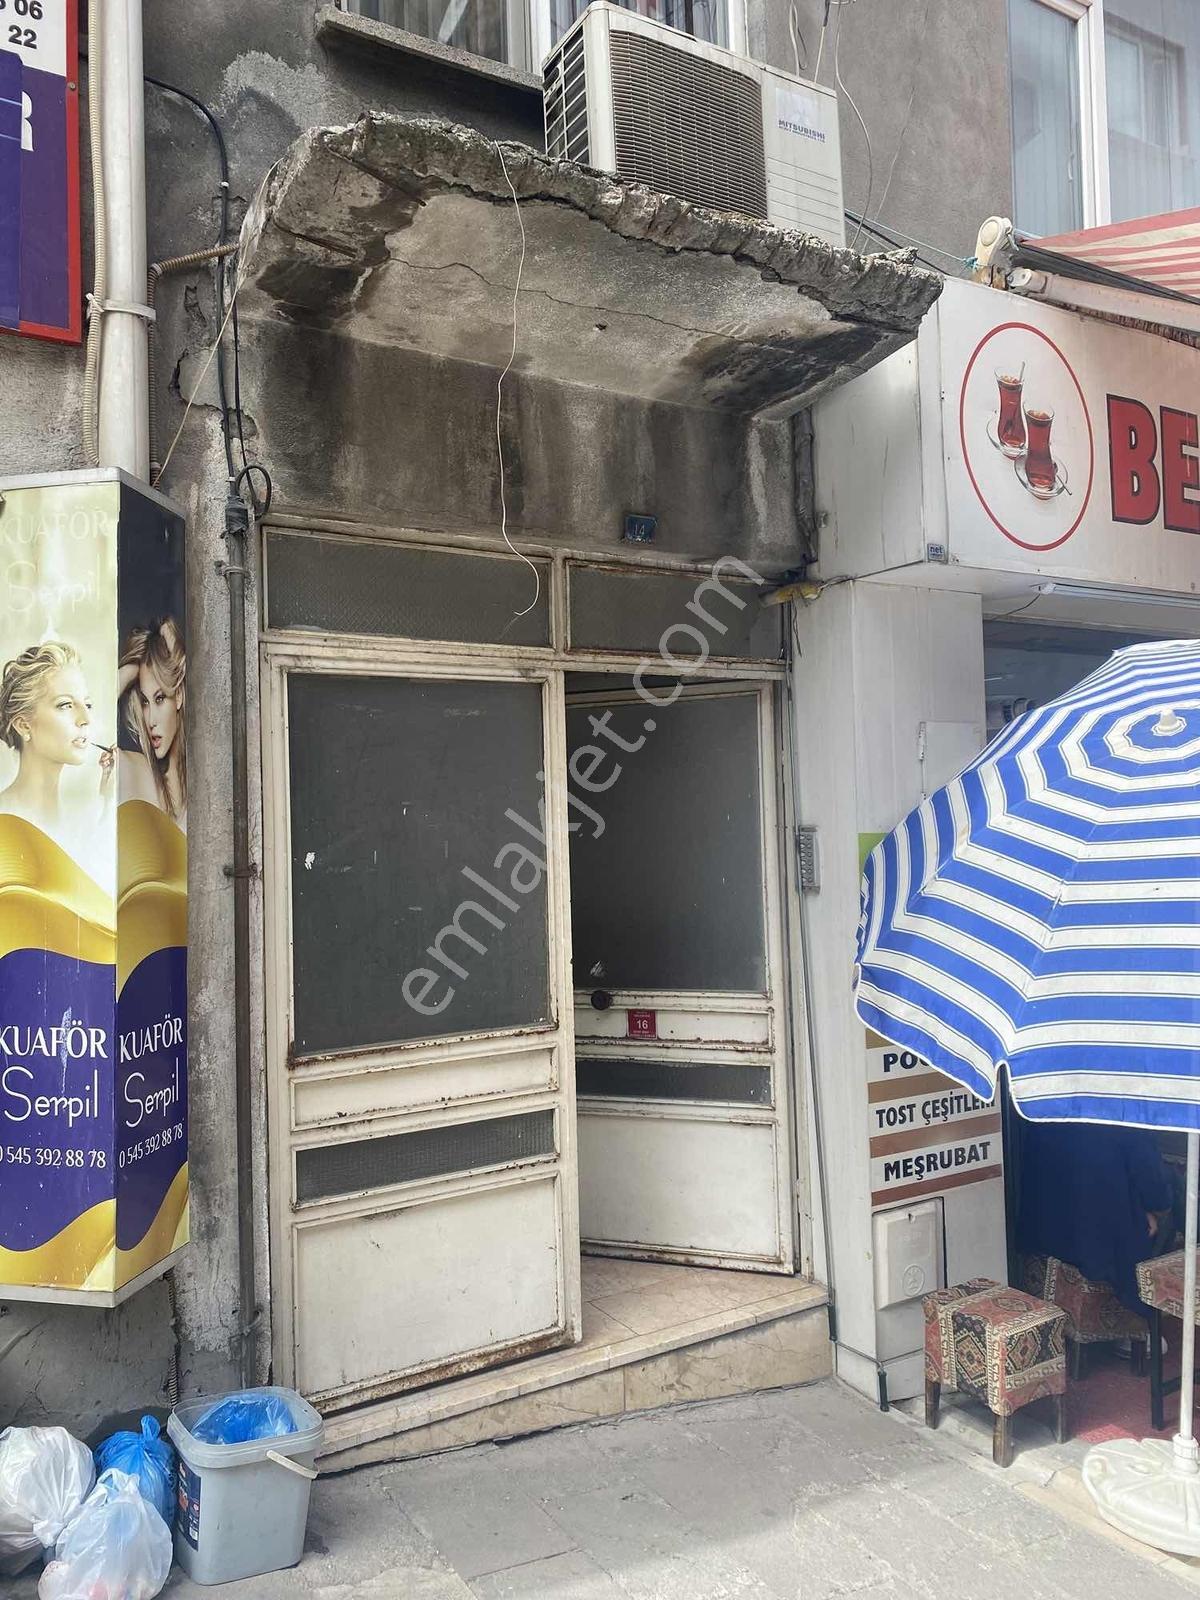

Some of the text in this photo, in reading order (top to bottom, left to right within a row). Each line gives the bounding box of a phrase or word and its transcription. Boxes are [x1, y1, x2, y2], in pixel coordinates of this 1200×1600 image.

[14, 0, 43, 20] 06
[8, 24, 37, 49] 22
[1106, 393, 1200, 535] BE
[0, 1019, 108, 1059] KUAFÖR
[119, 1013, 184, 1063] KUAFÖR
[636, 1019, 649, 1030] 16
[883, 1050, 930, 1073] PO
[2, 1065, 99, 1128] Serpil
[124, 1057, 180, 1128] Serpil
[876, 1103, 917, 1128] TOST
[6, 1146, 32, 1165] 545
[35, 1148, 62, 1167] 392
[65, 1149, 85, 1168] 88
[87, 1149, 107, 1169] 78
[119, 1122, 183, 1168] 0 545 392 88 78
[884, 1141, 991, 1181] MEŞRUBAT
